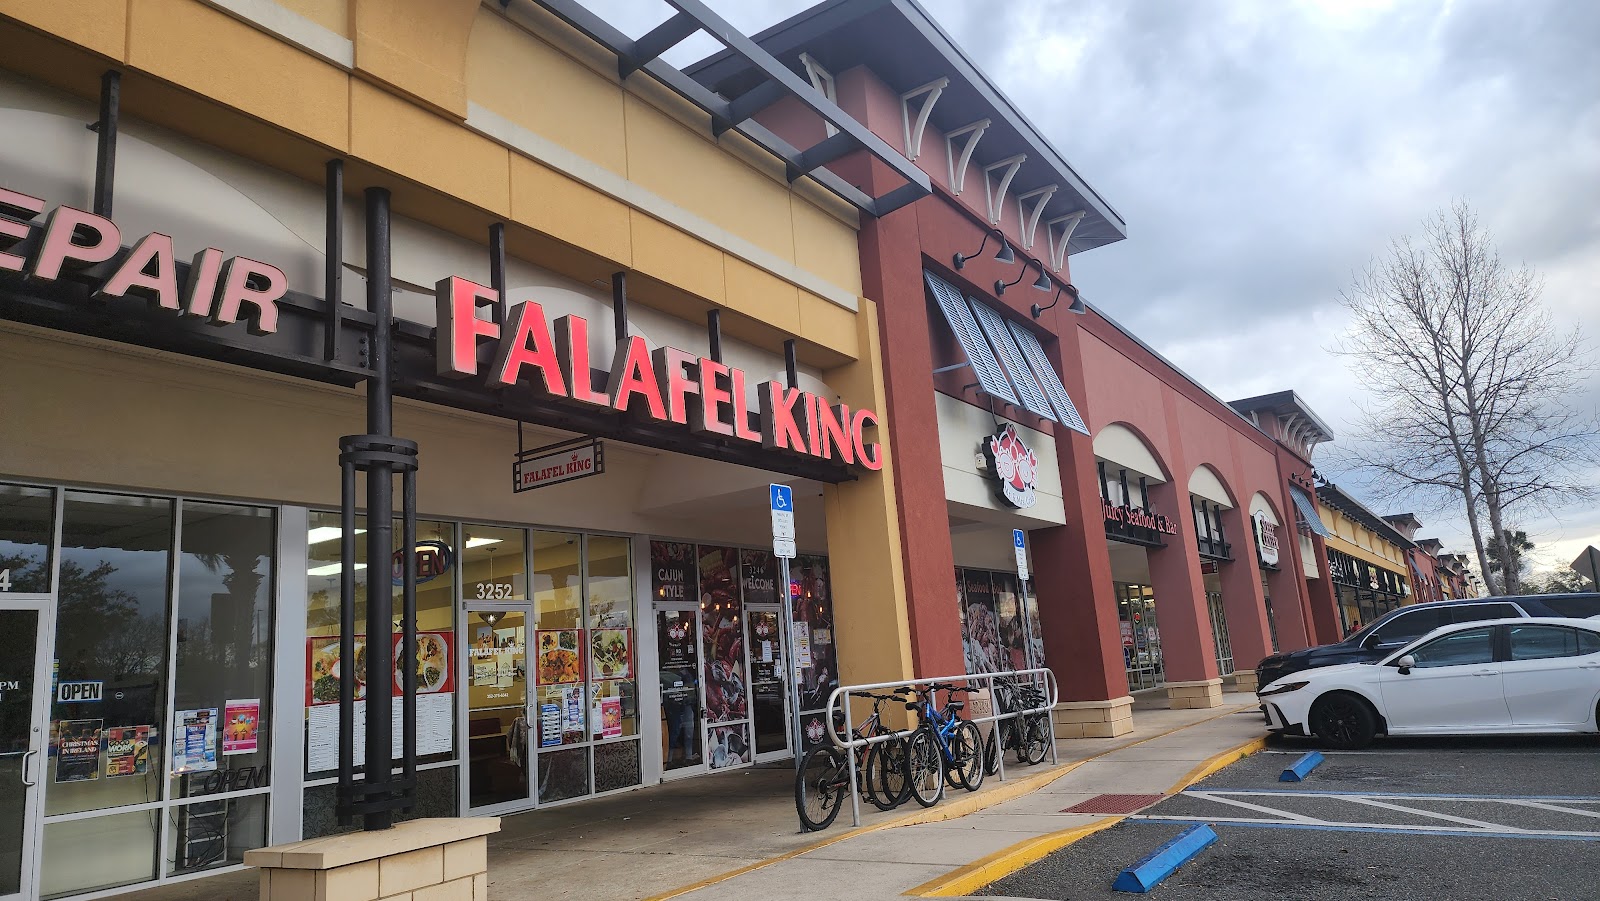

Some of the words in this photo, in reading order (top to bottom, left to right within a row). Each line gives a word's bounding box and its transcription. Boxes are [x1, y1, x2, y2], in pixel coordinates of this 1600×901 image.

[446, 275, 763, 444] FALAFEL
[768, 380, 883, 471] KING
[524, 465, 565, 484] FALAFEL
[566, 458, 591, 474] KING
[1101, 498, 1124, 529] Juicy
[1125, 504, 1157, 530] Seafood
[1157, 513, 1166, 532] &
[1165, 516, 1178, 534] Bar
[391, 548, 445, 578] OEN
[658, 568, 684, 581] CAJUN
[476, 583, 513, 600] 3252
[742, 578, 774, 590] WELCOME
[469, 647, 505, 657] FALAFEL
[505, 646, 525, 655] KING
[61, 683, 100, 700] OPEN
[61, 740, 99, 748] CHRISTMAS
[109, 744, 134, 753] WORK
[204, 765, 267, 793] OPEN
